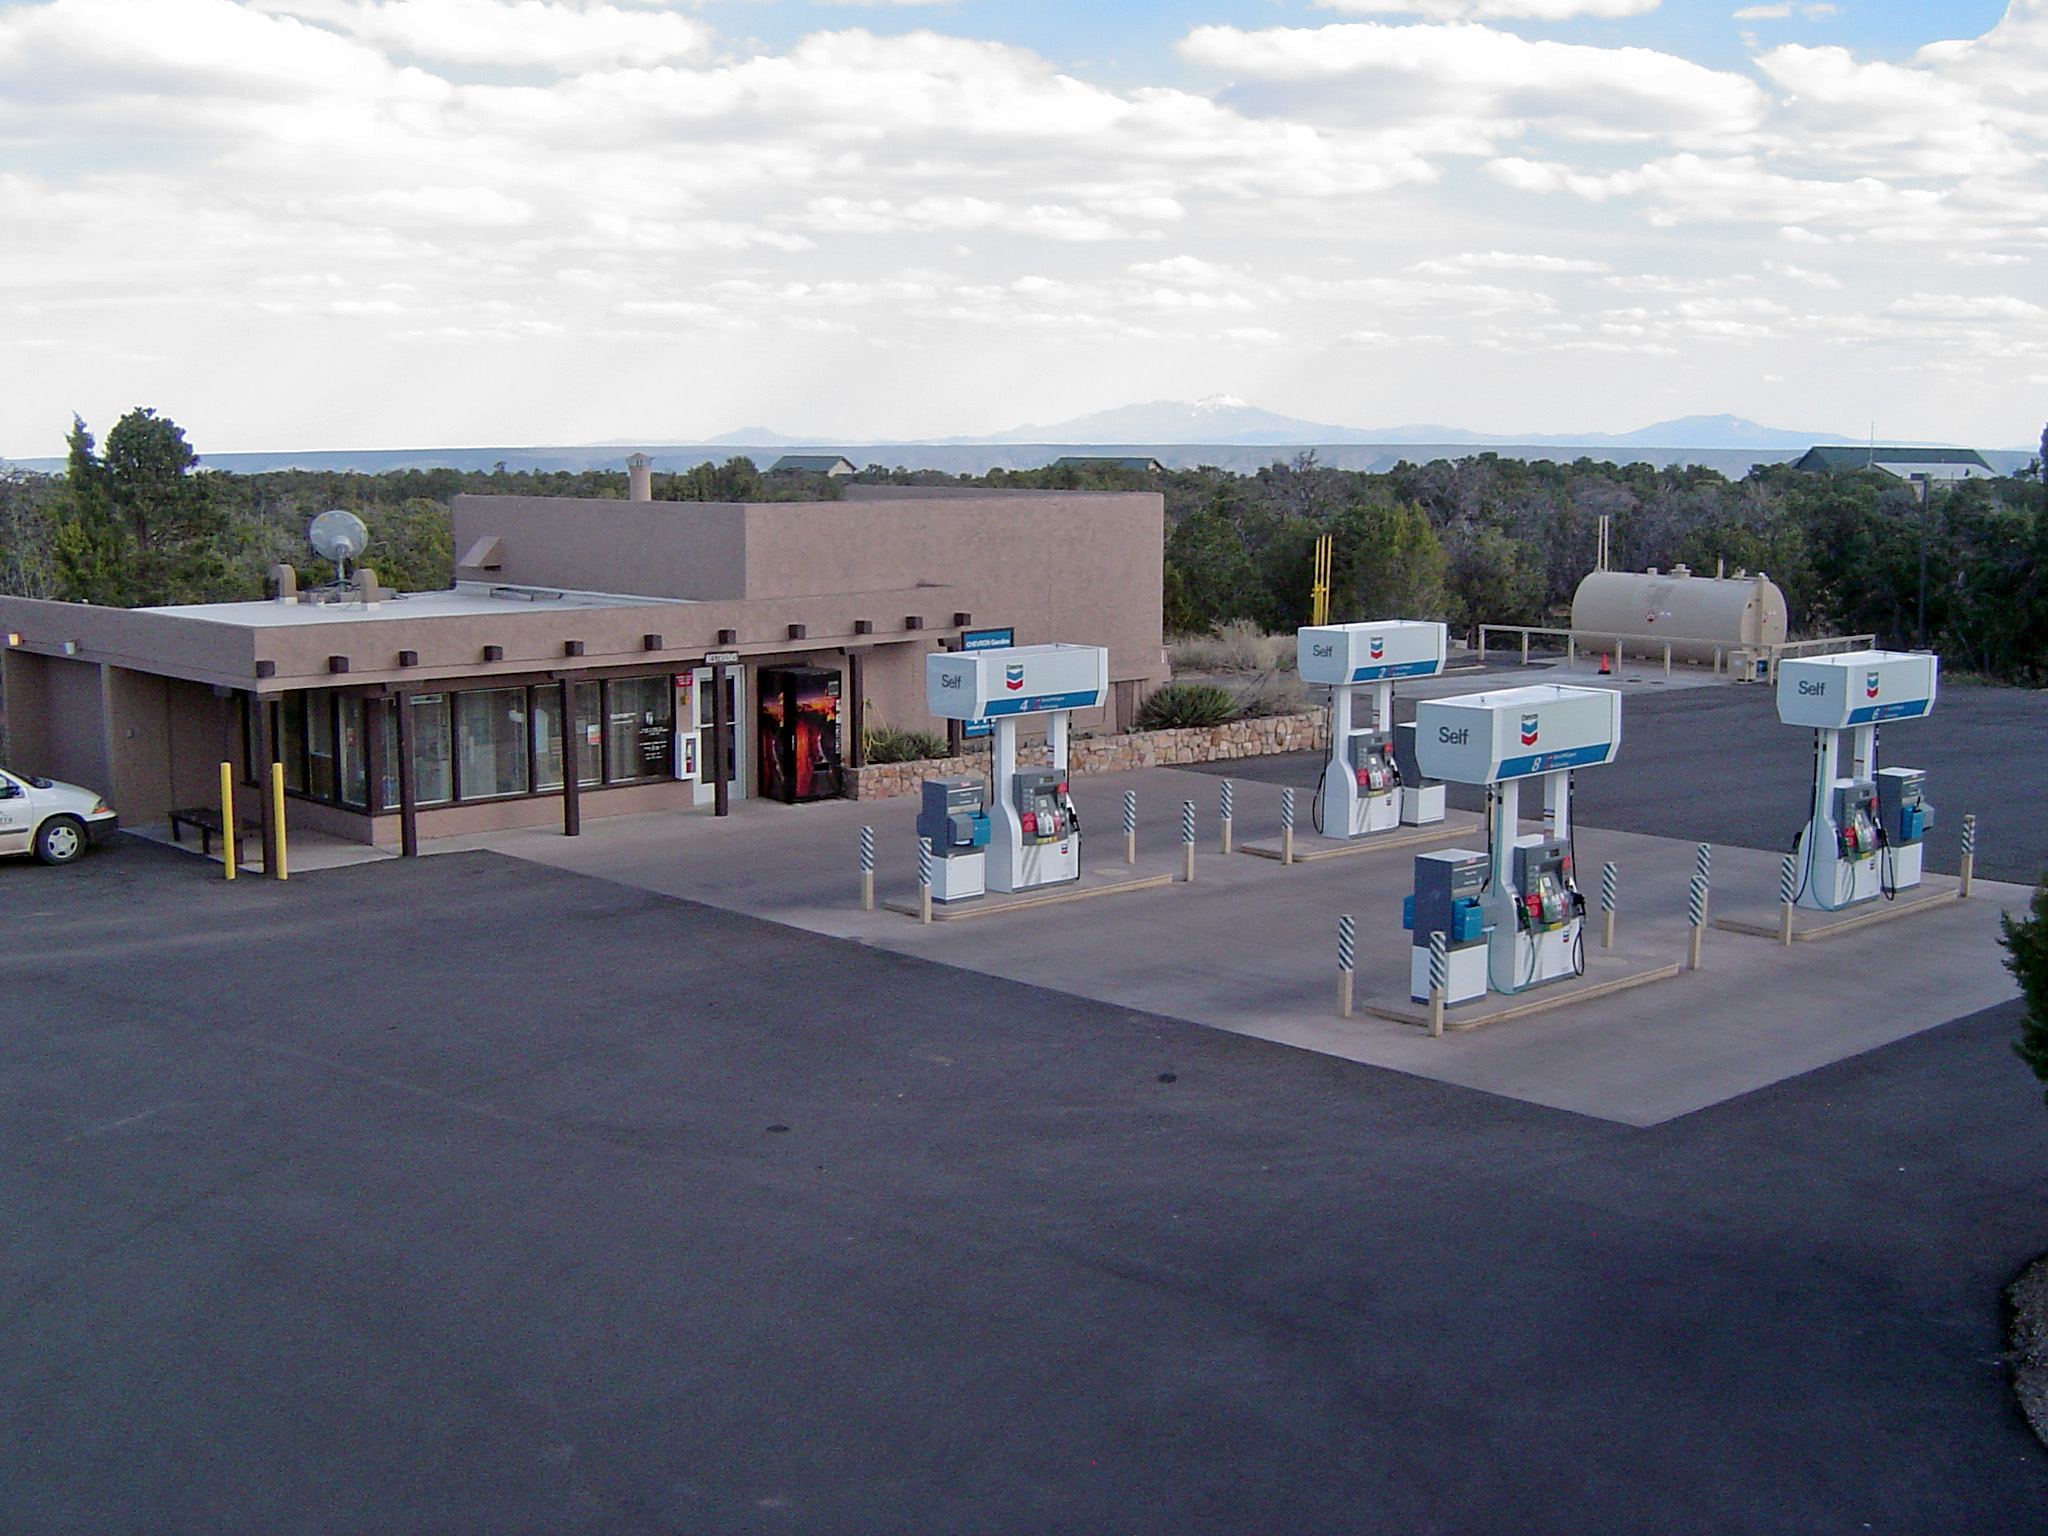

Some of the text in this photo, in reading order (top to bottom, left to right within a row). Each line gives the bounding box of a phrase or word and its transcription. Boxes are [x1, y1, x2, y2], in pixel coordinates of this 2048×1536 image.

[1313, 645, 1332, 657] Self
[941, 674, 961, 688] Self
[1799, 681, 1825, 696] Self
[1020, 700, 1028, 711] 4
[1439, 727, 1468, 745] Self
[1532, 757, 1541, 771] 8
